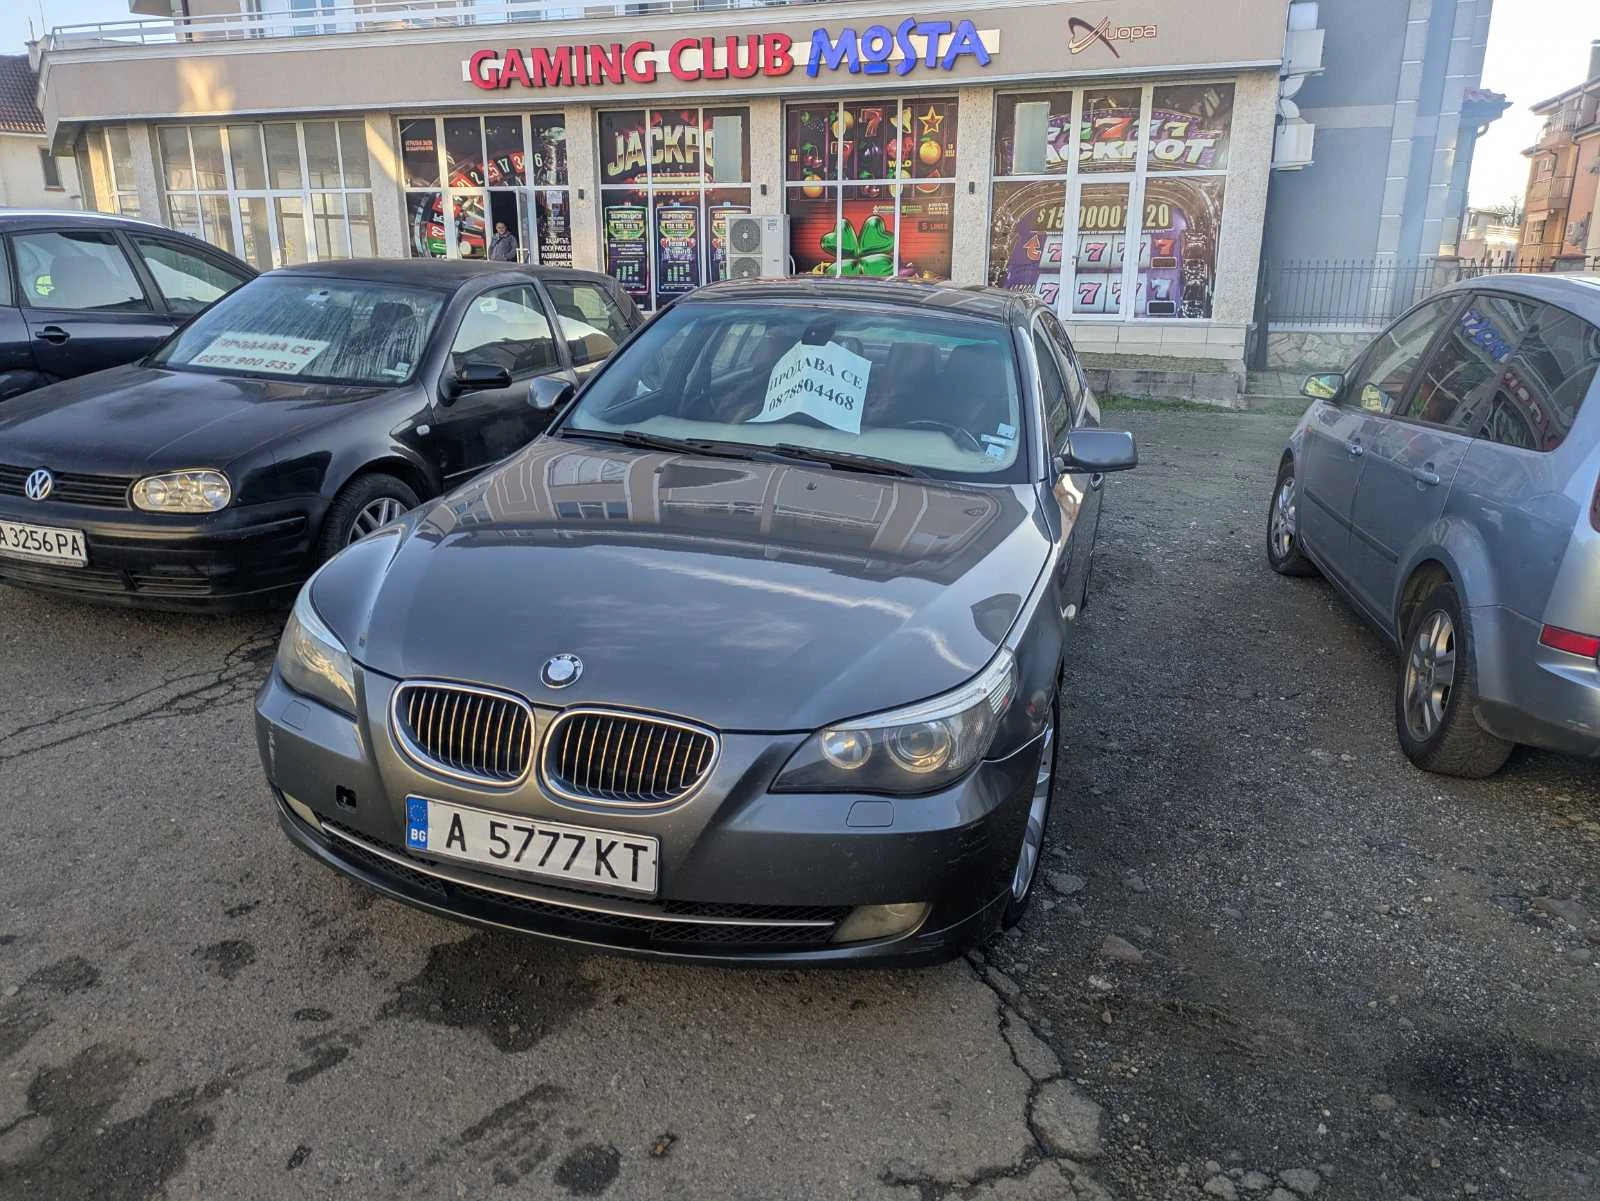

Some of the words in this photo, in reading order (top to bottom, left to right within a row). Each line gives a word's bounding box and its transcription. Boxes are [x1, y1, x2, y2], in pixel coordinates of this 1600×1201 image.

[469, 41, 658, 90] GAMING
[667, 32, 794, 81] CLUB
[806, 17, 992, 78] MOSTA
[607, 125, 715, 177] JACKPO
[1047, 138, 1216, 164] ACKPOT
[769, 357, 835, 391] ПРОДАВА
[841, 369, 863, 389] СЕ
[768, 378, 854, 412] 0878804468
[411, 828, 427, 842] BG
[446, 813, 467, 852] A
